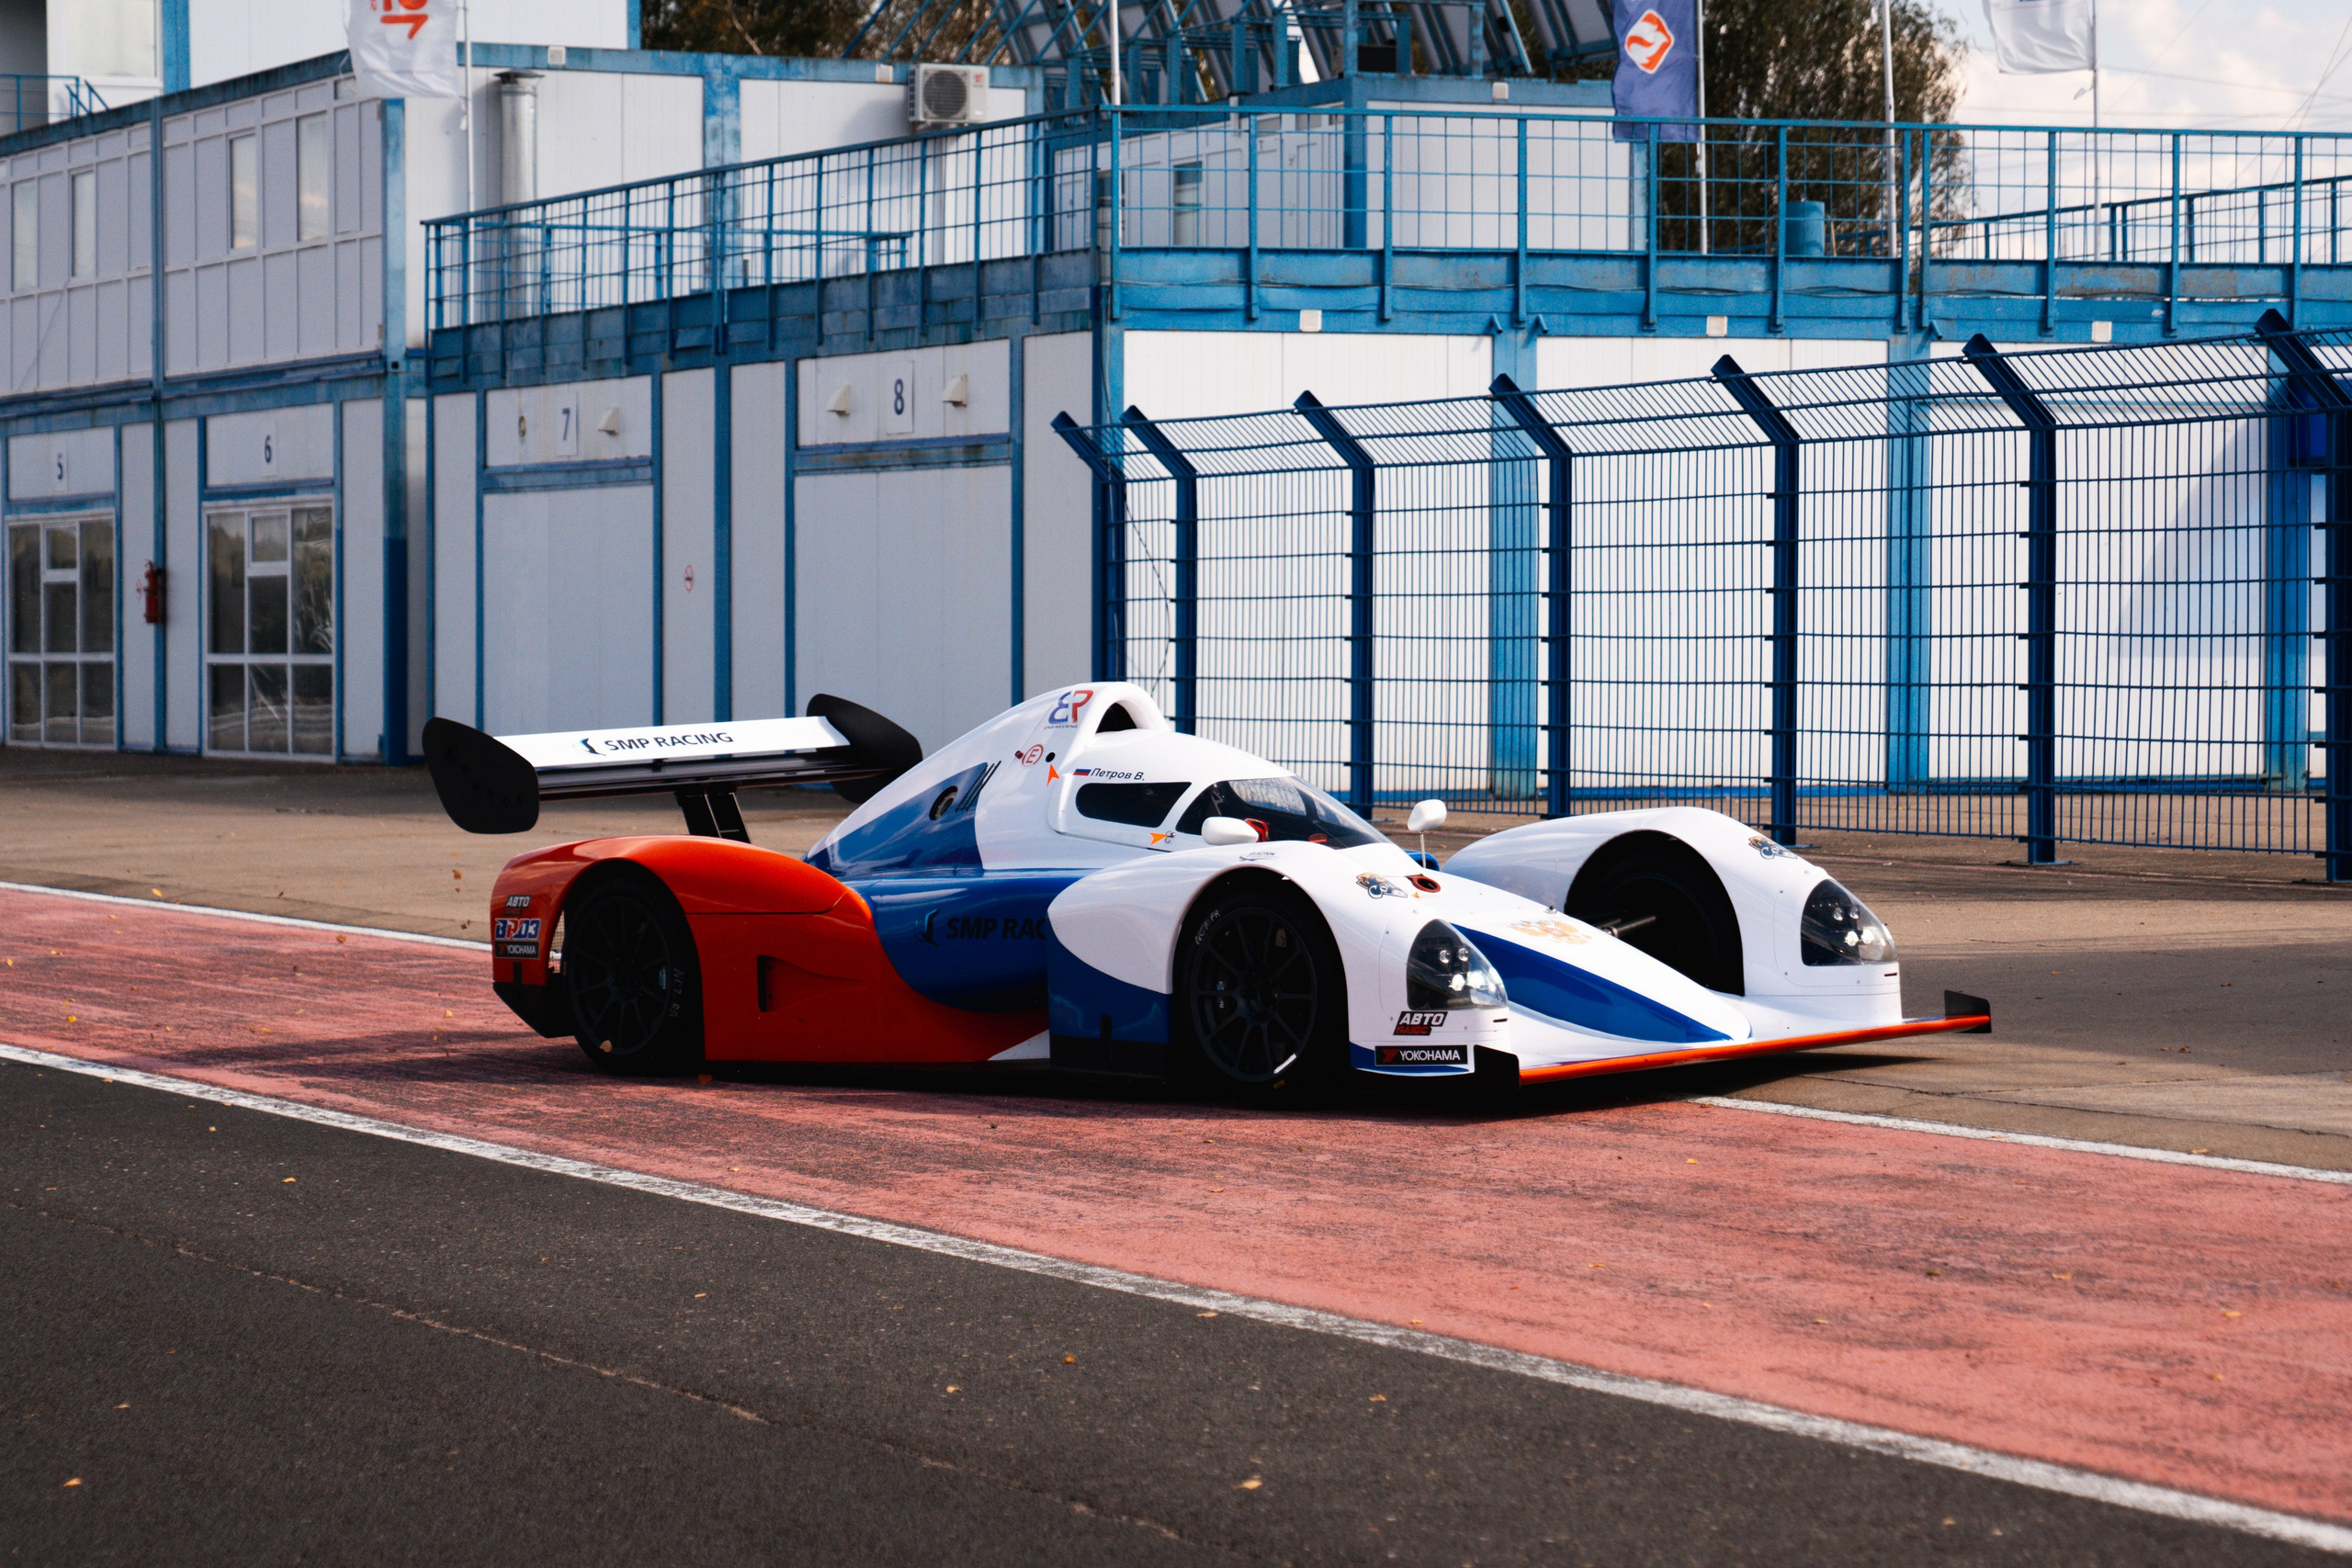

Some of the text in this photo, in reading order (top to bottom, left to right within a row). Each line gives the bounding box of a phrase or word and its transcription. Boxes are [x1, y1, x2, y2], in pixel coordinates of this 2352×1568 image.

[894, 378, 905, 415] 8
[561, 408, 571, 441] 7
[264, 434, 272, 463] 6
[57, 452, 63, 480] 5
[605, 732, 734, 751] SMP RACING
[1091, 768, 1145, 781] Петров В.
[506, 897, 530, 907] АВТО
[946, 918, 998, 940] SMP
[506, 944, 536, 954] YOKOHAMA
[1399, 1012, 1445, 1026] АВТО
[1399, 1049, 1461, 1061] YOKOHAMA
